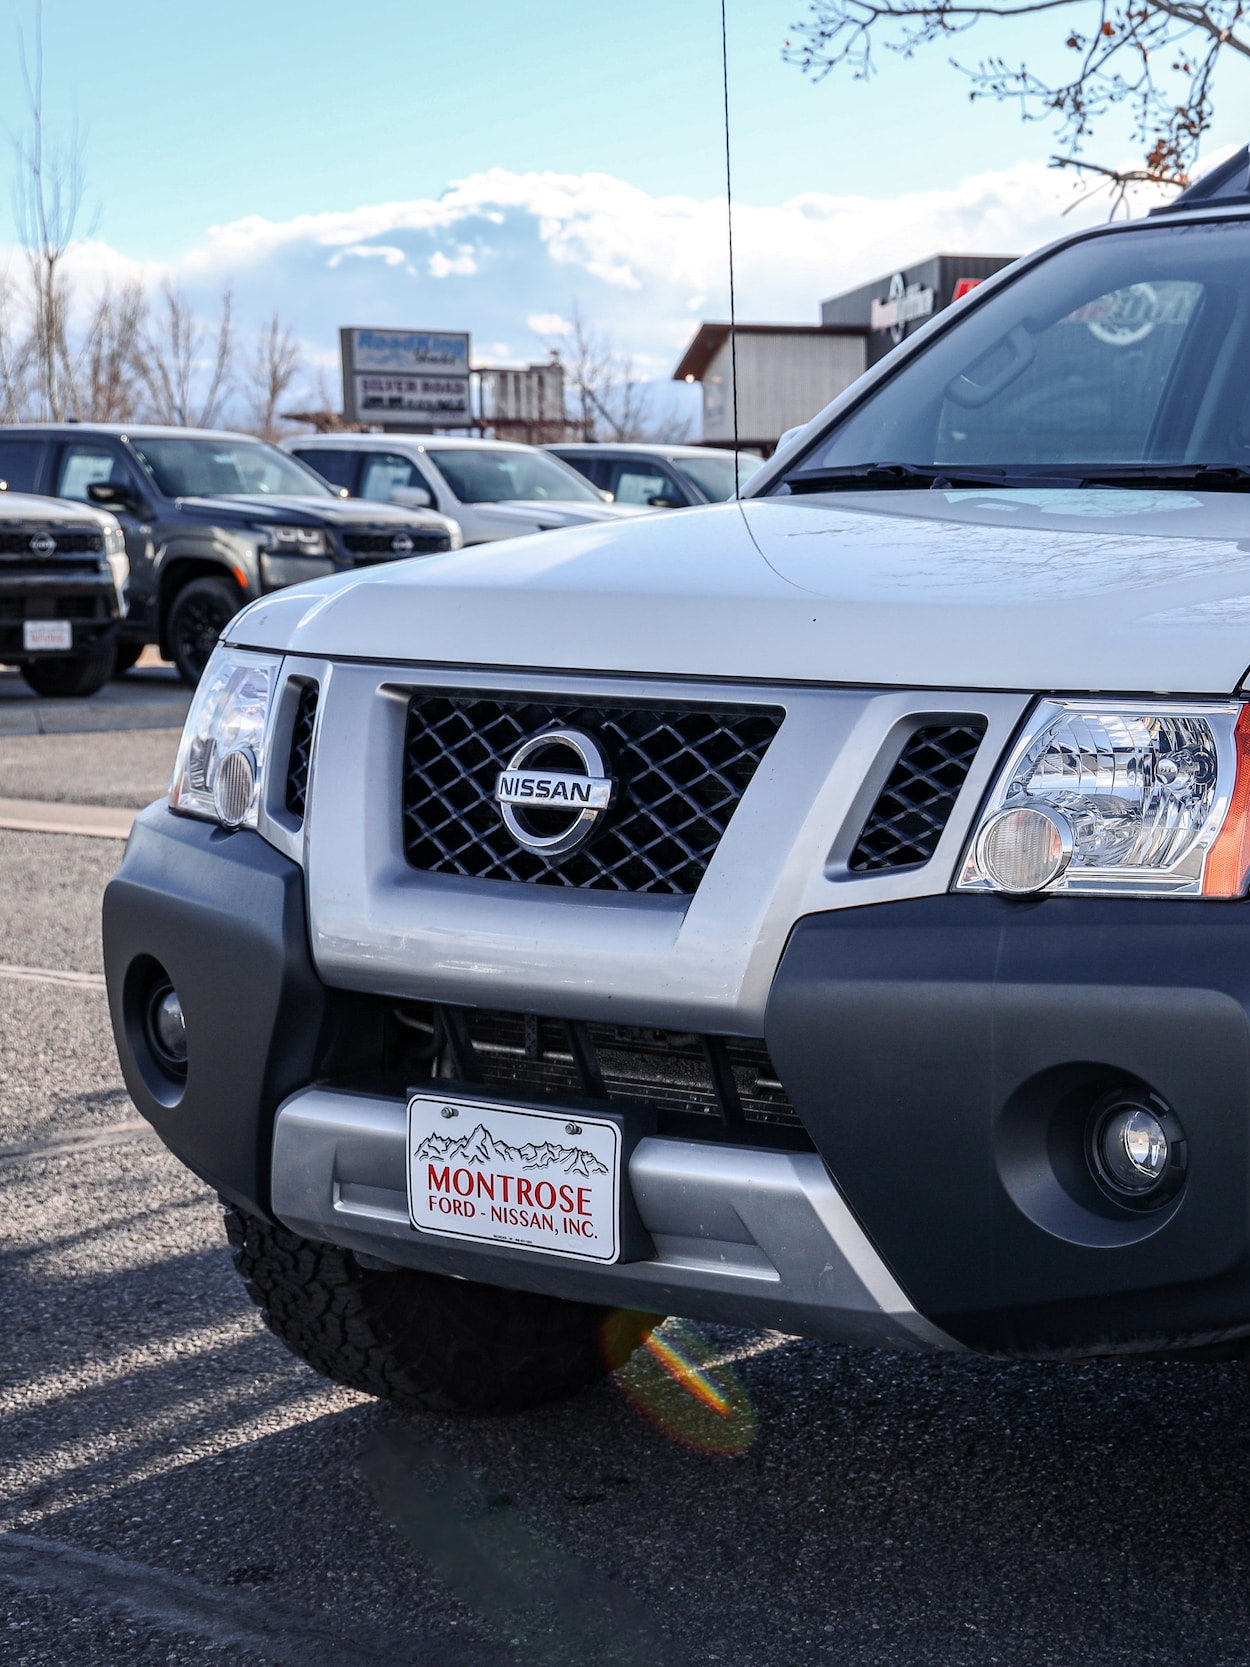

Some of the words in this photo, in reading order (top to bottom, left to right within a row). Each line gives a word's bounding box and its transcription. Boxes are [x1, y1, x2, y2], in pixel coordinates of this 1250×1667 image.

[499, 777, 591, 802] NISSAN
[428, 1164, 593, 1217] MONTROSE
[429, 1195, 476, 1218] FORD
[491, 1206, 560, 1236] NISSAN,
[563, 1217, 599, 1240] INC.
